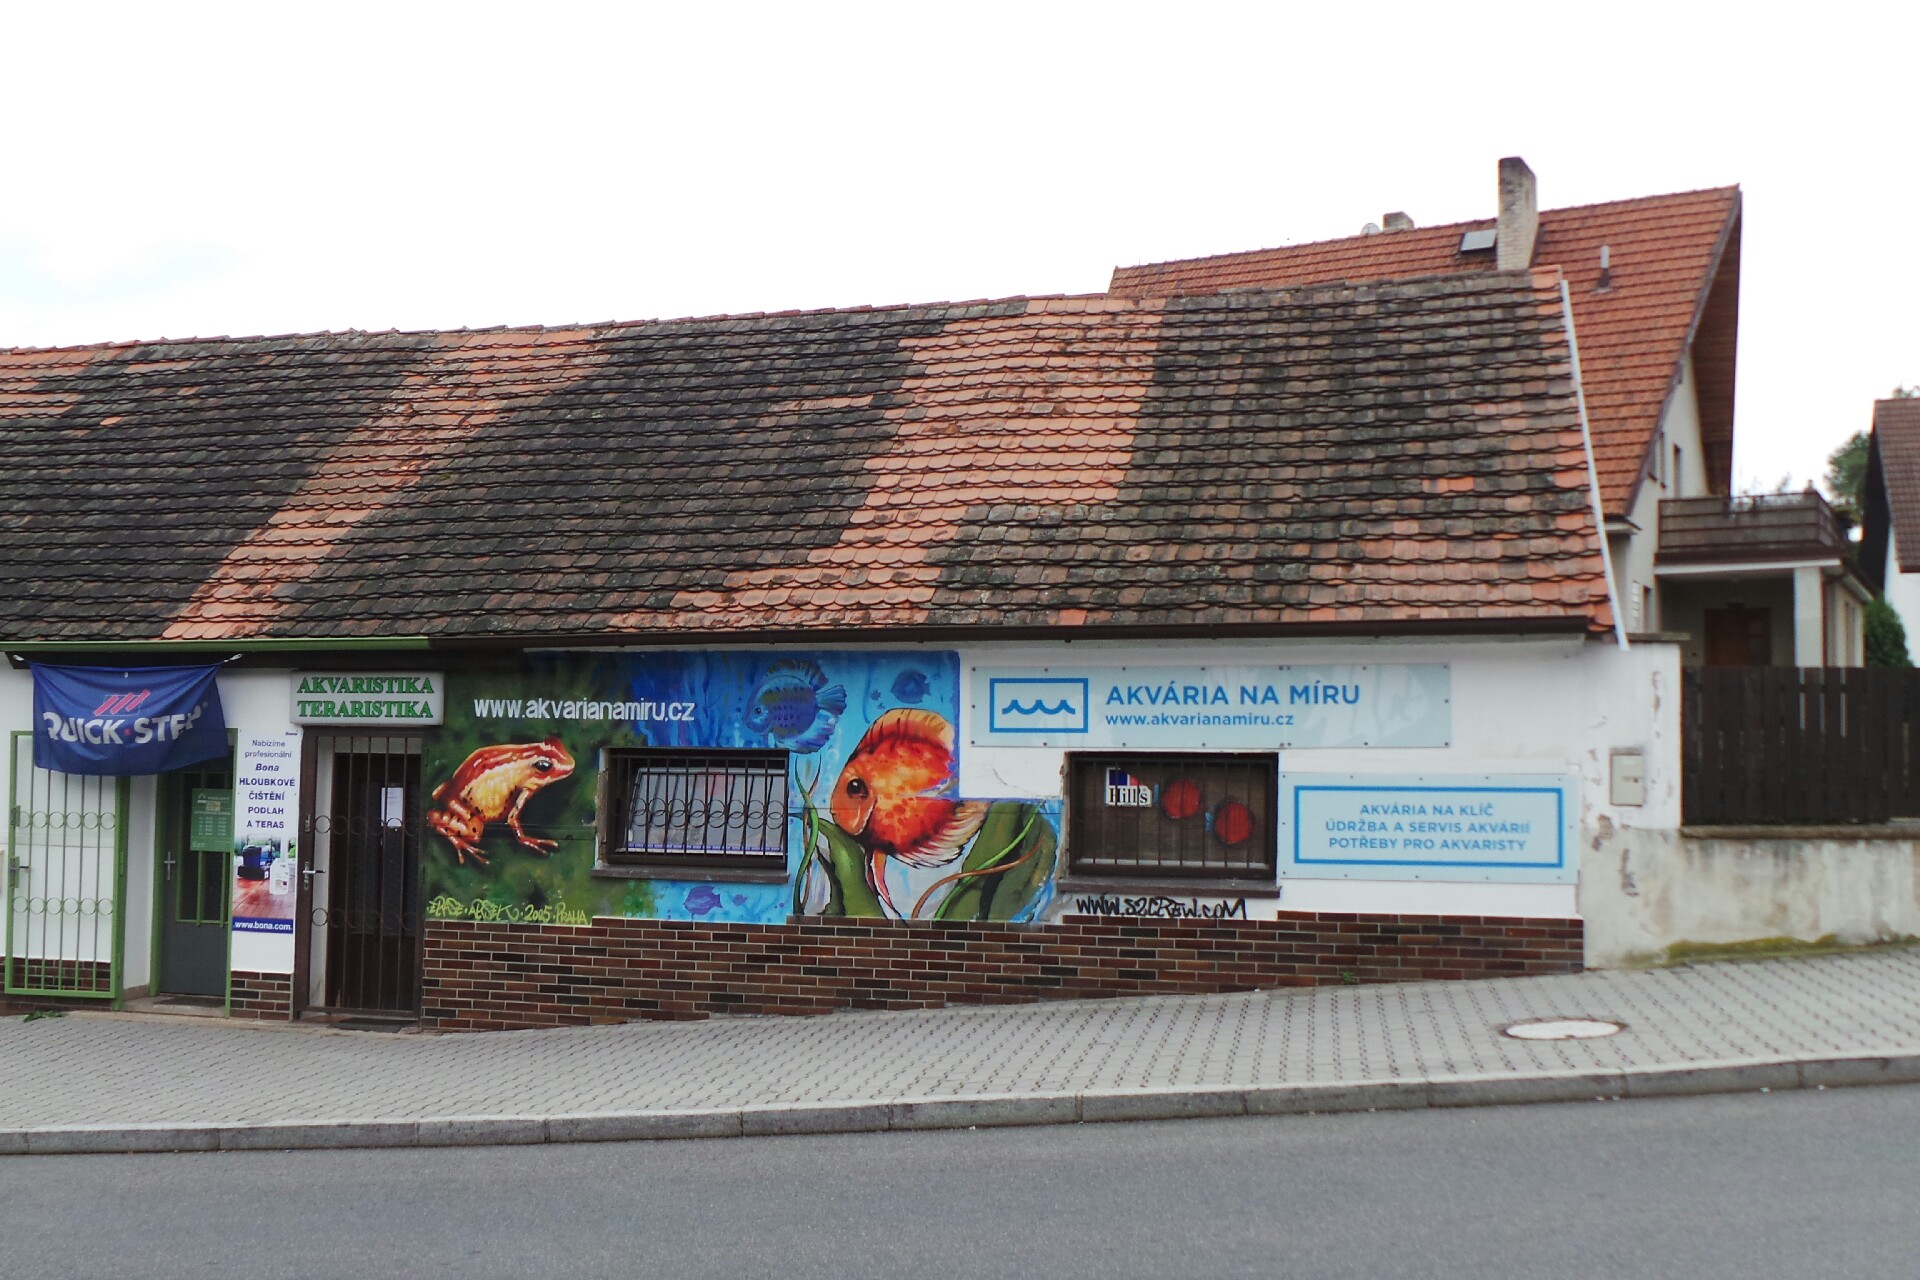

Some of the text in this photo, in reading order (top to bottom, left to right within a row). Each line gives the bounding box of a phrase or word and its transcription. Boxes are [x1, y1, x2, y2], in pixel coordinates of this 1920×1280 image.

[297, 676, 434, 694] AKVARISTIKA
[1105, 680, 1361, 706] AKVÁRIA NA MÍRU
[297, 700, 434, 719] TERARISTIKA
[474, 697, 696, 722] www.akvarianamiru.cz
[1105, 712, 1294, 726] www.akvarianamiru.cz
[43, 711, 126, 745] QUICK
[244, 750, 292, 759] profesionální
[255, 763, 280, 772] Bona
[239, 777, 296, 787] HLOUBKOVÉ
[248, 790, 285, 801] ČIŠTĚNÍ
[247, 806, 285, 815] PODLAH
[1360, 802, 1494, 816] AKVÁRIA NA KLÍČ
[246, 820, 285, 829] A TERAS
[1325, 818, 1531, 834] ÚDRŽBA A SERVIS AKVÁRIÍ
[1329, 835, 1526, 851] POTŘEBY PRO AKVARISTY
[234, 921, 291, 931] www.bona.com
